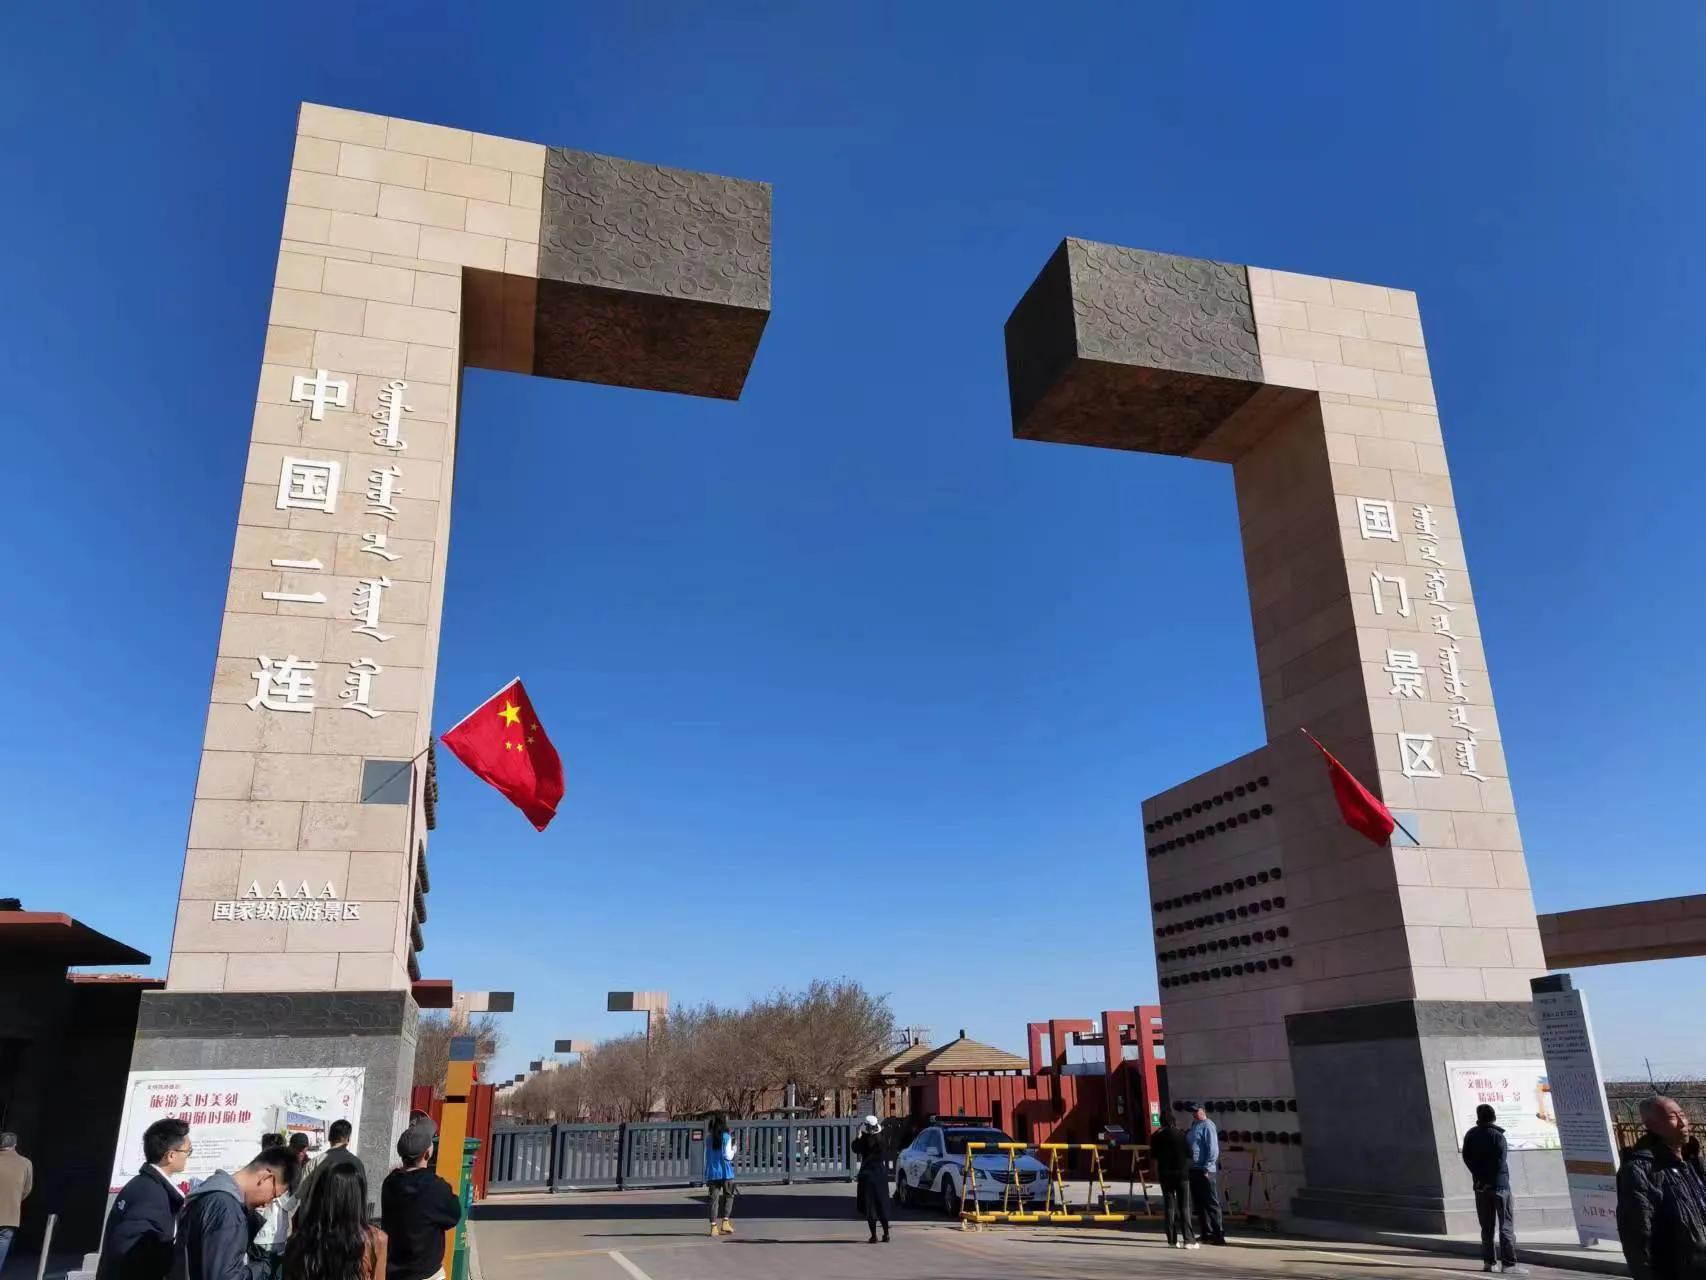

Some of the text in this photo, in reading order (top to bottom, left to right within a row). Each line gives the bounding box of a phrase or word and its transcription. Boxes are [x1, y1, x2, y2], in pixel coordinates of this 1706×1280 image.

[245, 369, 349, 713] 中国二连
[1356, 497, 1442, 779] 国门景区
[212, 900, 361, 921] 国家级旅游景区
[149, 1092, 239, 1108] 旅游美时美刻
